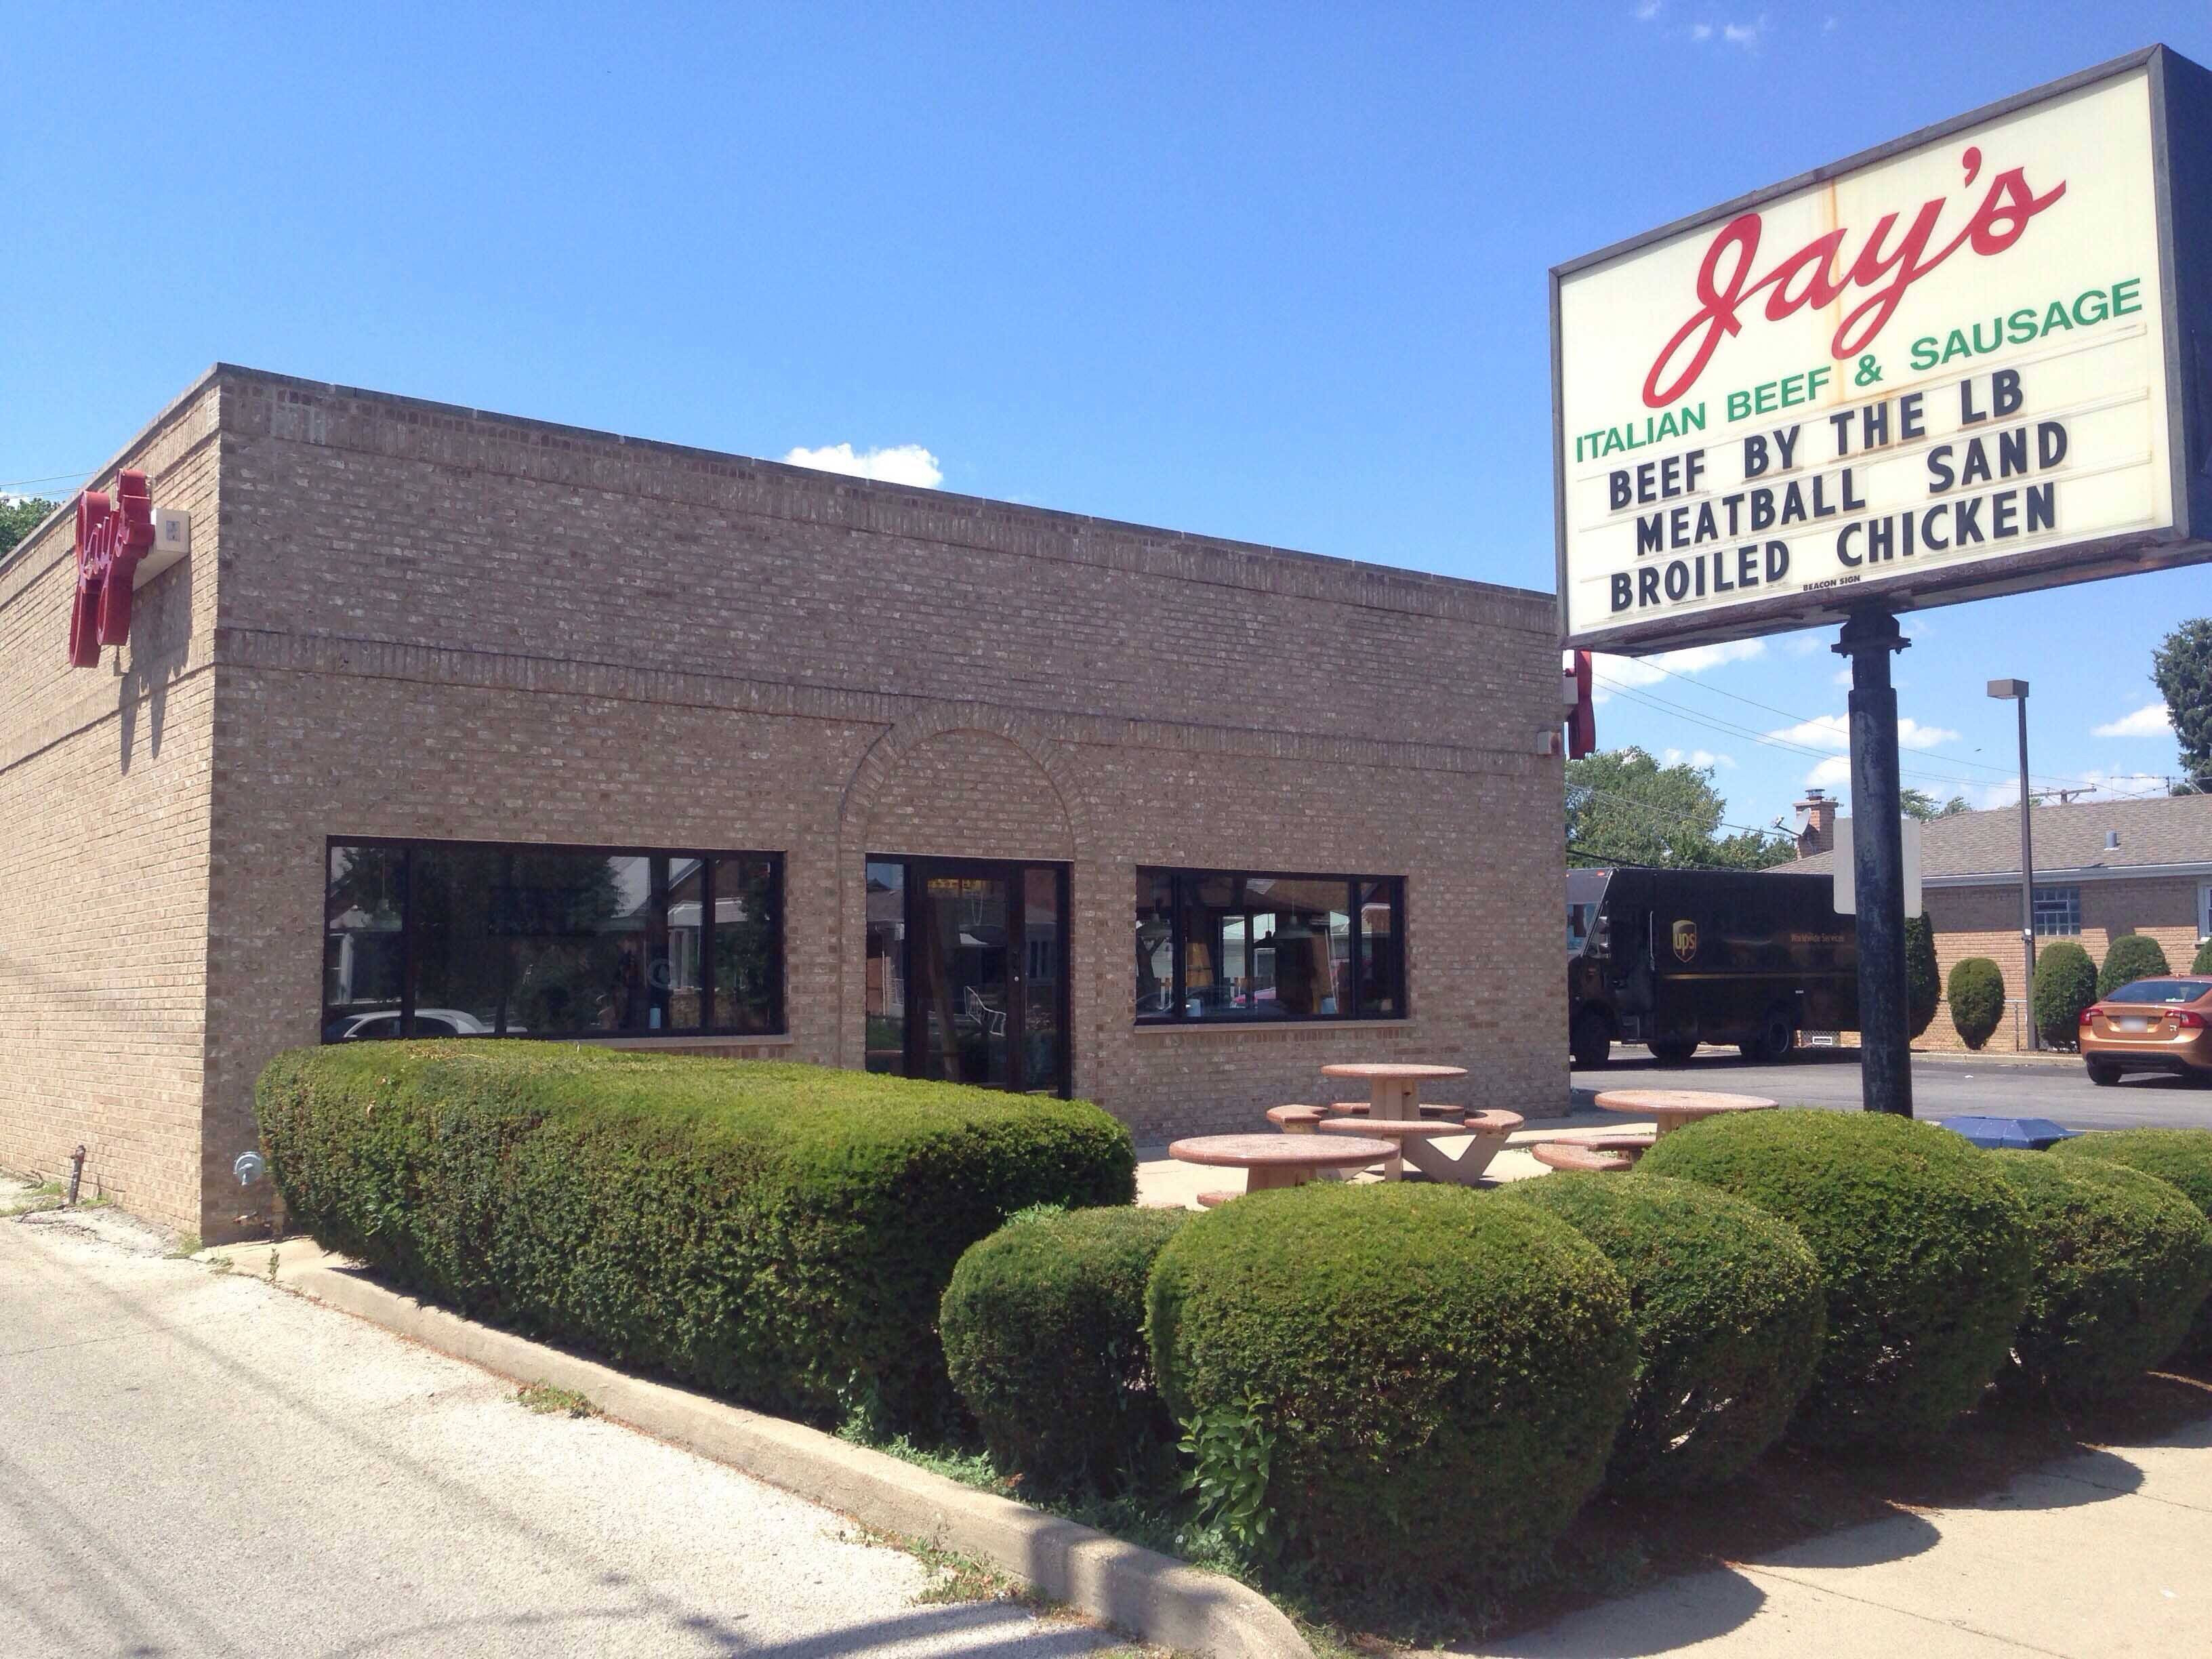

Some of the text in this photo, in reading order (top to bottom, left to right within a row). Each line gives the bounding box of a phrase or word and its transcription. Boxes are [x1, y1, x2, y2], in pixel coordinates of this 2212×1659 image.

[1642, 146, 2066, 409] Jay's
[1576, 277, 2142, 463] ITALIAN BEEF & SAUSAGE
[1610, 369, 2024, 511] BEEF BY THE LB
[1637, 420, 2068, 556] MEATBALL SAND
[1611, 482, 2055, 613] BROILED CHICKEN
[1803, 575, 1860, 591] BEACON SIGN
[1675, 933, 1696, 956] ups
